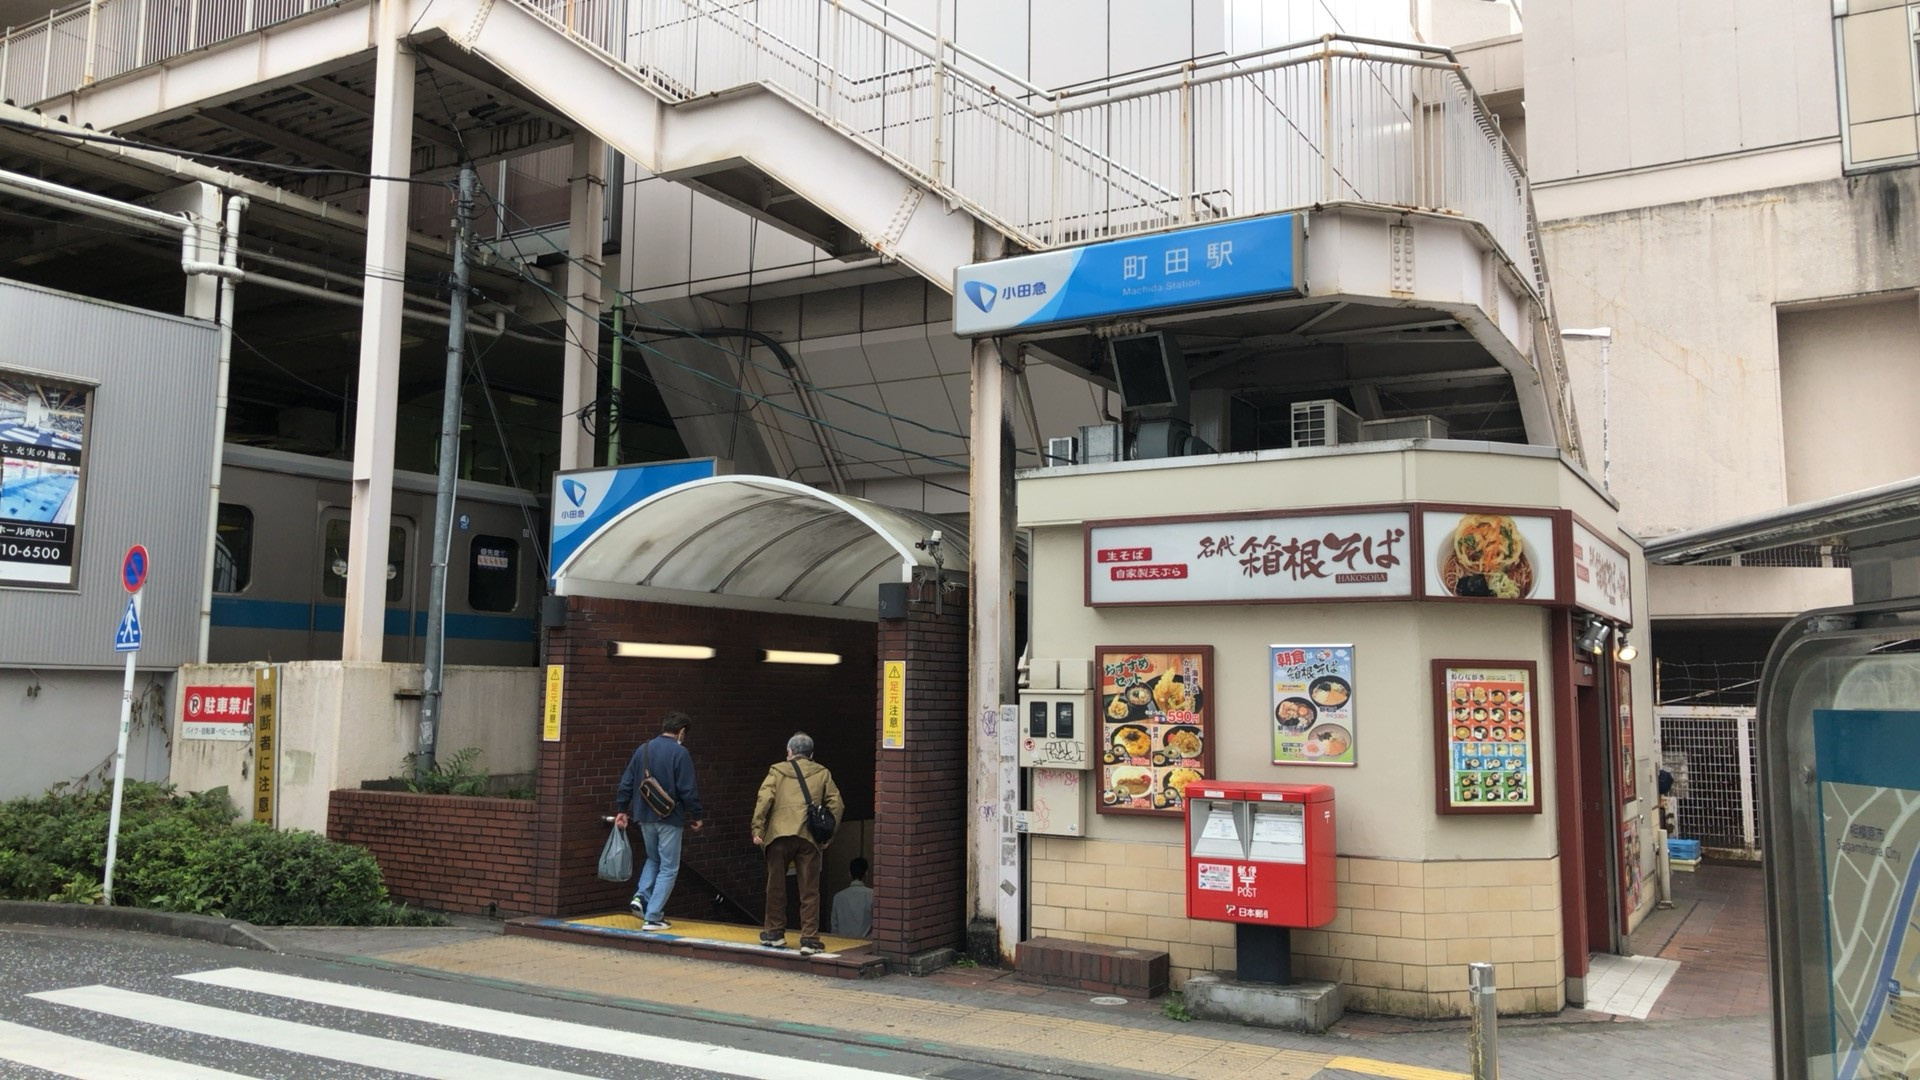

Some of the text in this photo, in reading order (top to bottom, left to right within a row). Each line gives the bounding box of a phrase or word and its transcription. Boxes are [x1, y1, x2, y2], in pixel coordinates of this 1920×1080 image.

[1123, 240, 1234, 281] 町田駅
[1002, 281, 1048, 301] 小田急
[1122, 278, 1201, 297] Machida Station
[1, 444, 72, 462] と、充実の施設。
[561, 509, 586, 520] 小田急
[0, 543, 60, 560] 10-6500
[1106, 549, 1146, 561] 生そば
[1197, 527, 1405, 582] 名代 箱根そば
[1115, 567, 1182, 579] 自家製天ぷら
[1337, 573, 1386, 582] HAKOSOBA
[1104, 657, 1149, 676] おすすめ
[1115, 672, 1142, 687] セット
[203, 696, 253, 716] 駐車禁止
[549, 682, 559, 724] 足元注意
[889, 681, 900, 729] 足元注意
[1167, 710, 1200, 724] 590円
[258, 693, 273, 813] 横断者に注意
[1849, 823, 1885, 842] 相模原市
[1836, 838, 1902, 863] Sagamihara City
[1237, 865, 1257, 879] 郵便
[1237, 886, 1257, 898] POST
